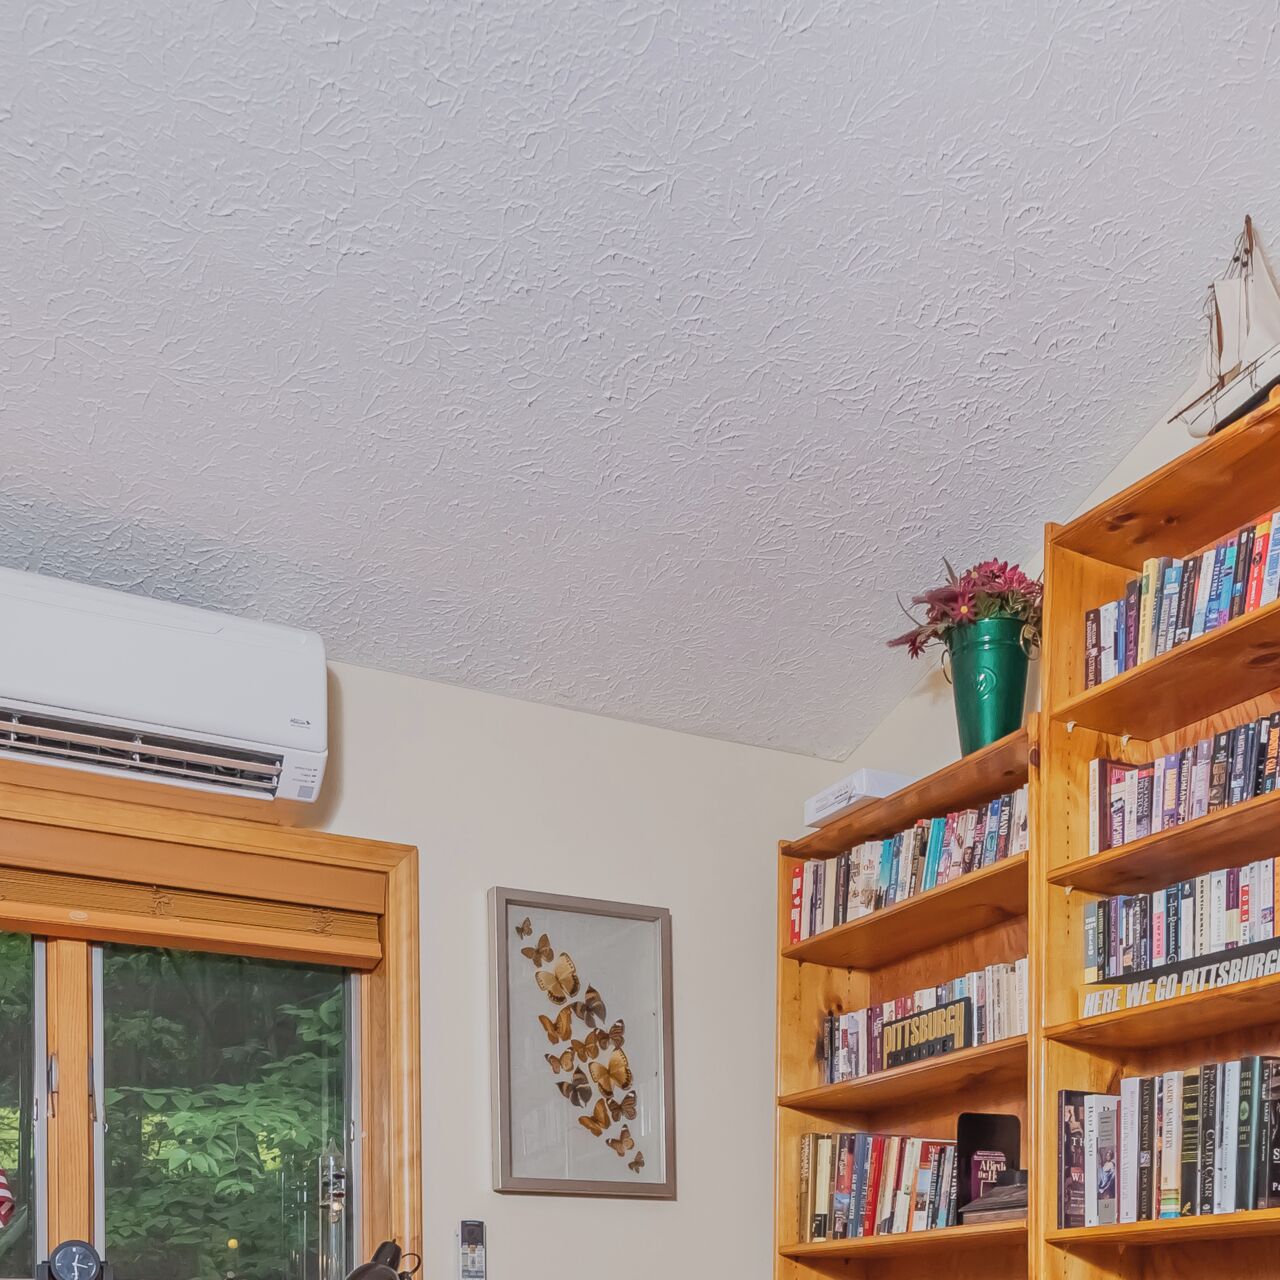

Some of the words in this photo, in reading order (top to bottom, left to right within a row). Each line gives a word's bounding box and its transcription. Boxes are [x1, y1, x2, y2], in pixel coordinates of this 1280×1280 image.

[1240, 886, 1249, 922] FORD
[1083, 986, 1122, 1018] HERE
[1126, 979, 1154, 1008] WE
[1155, 973, 1178, 1001] GO
[883, 1002, 965, 1070] PITTSBURGH
[1204, 1129, 1214, 1165] CALEB
[1204, 1167, 1213, 1197] CARR
